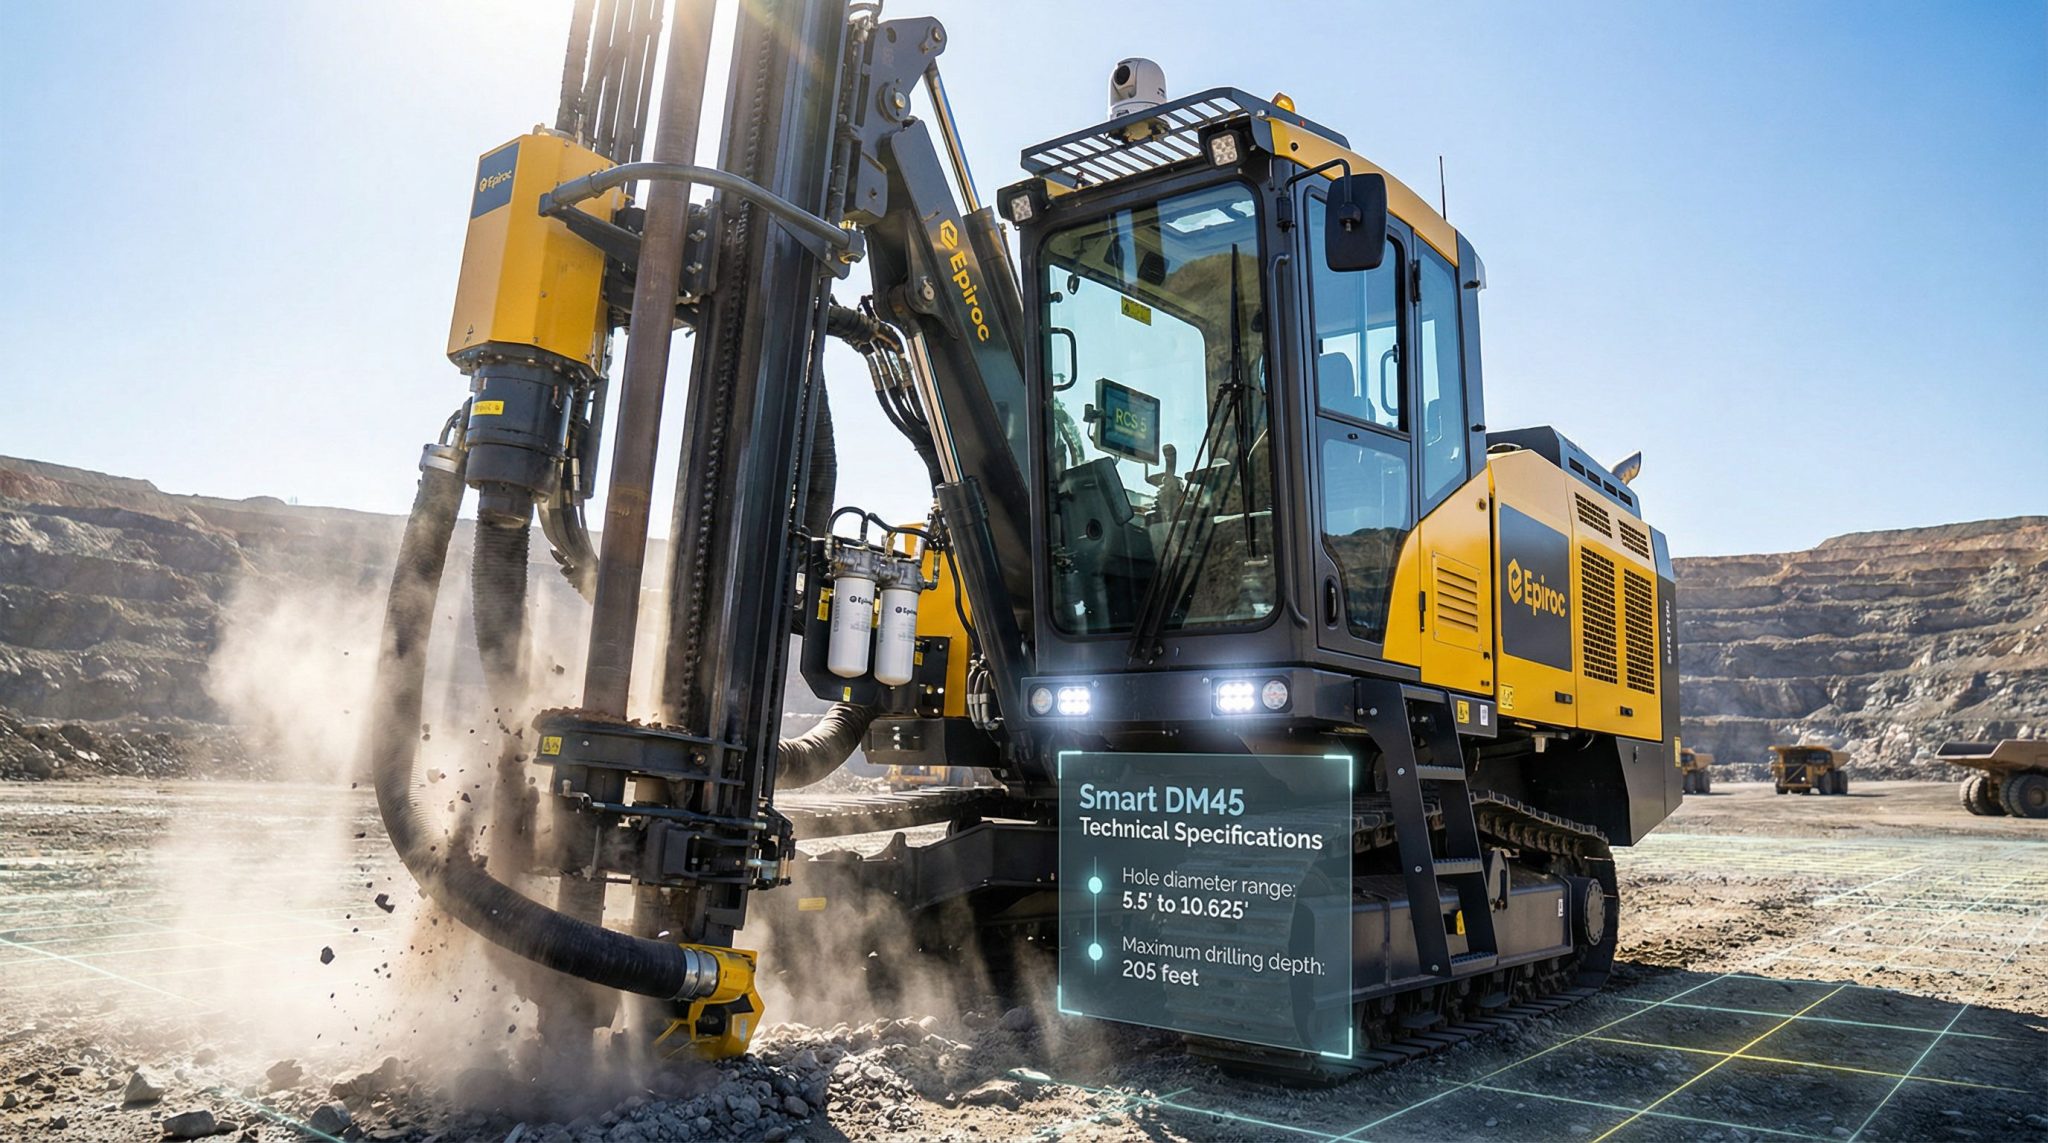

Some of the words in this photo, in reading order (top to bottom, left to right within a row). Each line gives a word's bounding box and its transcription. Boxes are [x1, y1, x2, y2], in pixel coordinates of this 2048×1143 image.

[949, 250, 990, 342] Epiroc
[1115, 407, 1138, 430] RCS
[1140, 417, 1147, 433] 5
[1524, 569, 1566, 617] Epiroc
